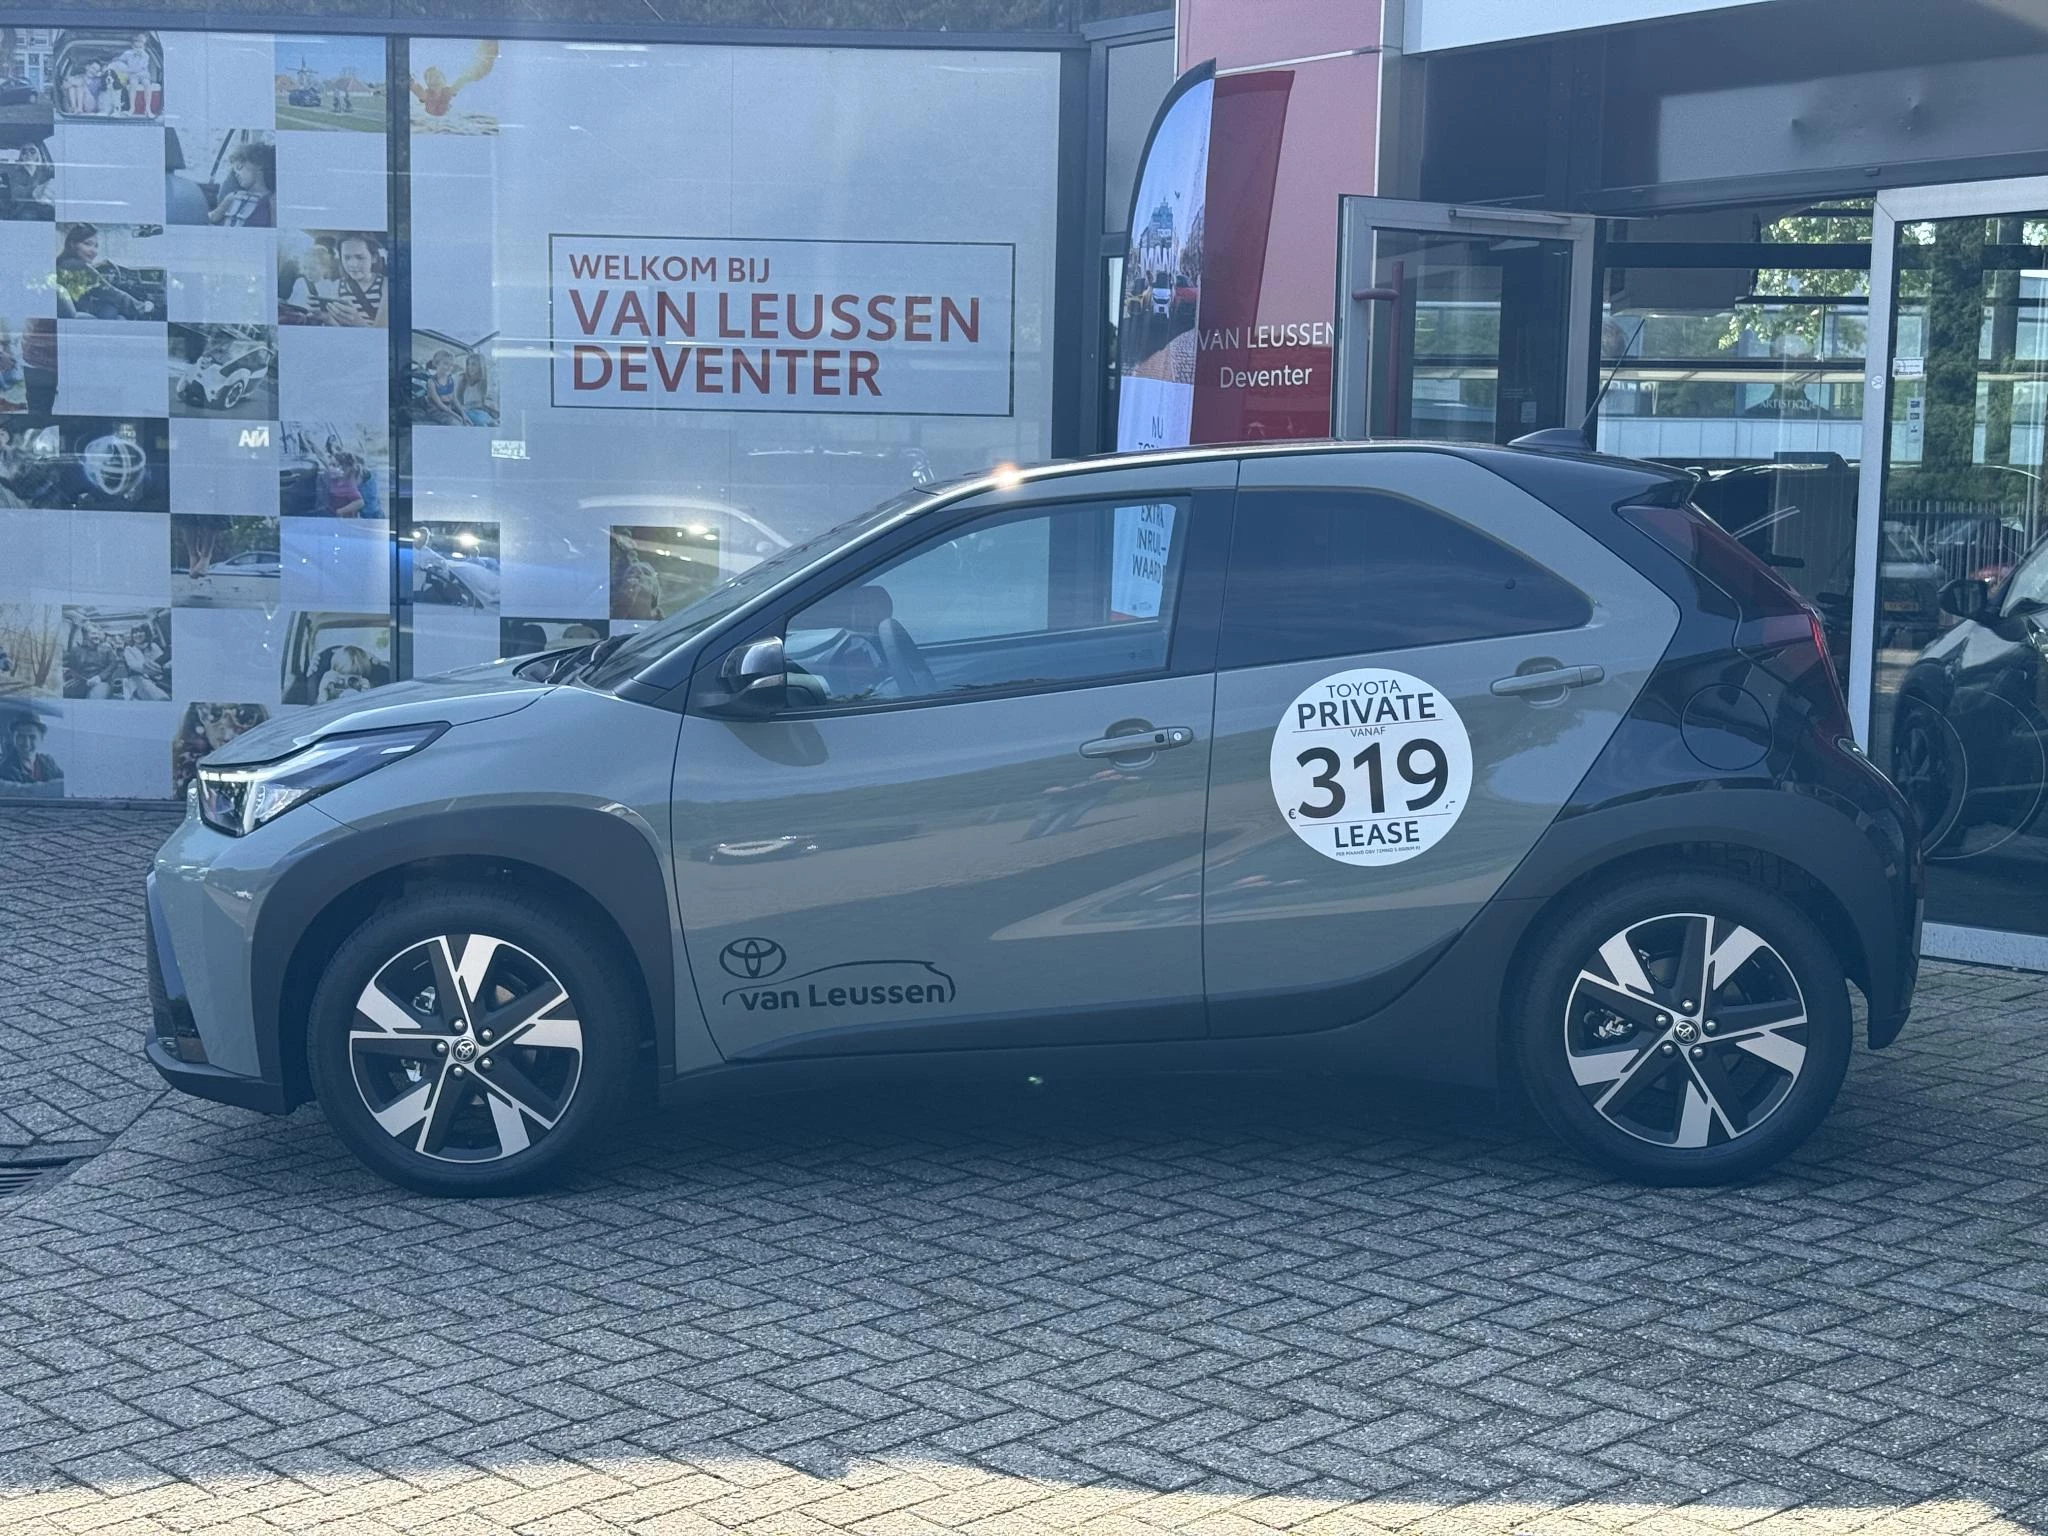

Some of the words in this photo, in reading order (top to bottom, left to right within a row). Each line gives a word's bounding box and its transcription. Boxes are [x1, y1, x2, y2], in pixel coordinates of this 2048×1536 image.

[569, 253, 717, 281] WELKOM
[728, 257, 770, 283] BIJ
[568, 289, 696, 338] VAN
[718, 292, 980, 343] LEUSSEN
[1198, 327, 1240, 351] VAN
[573, 345, 882, 396] DEVENTER
[1219, 365, 1313, 389] Deventer
[1760, 399, 1818, 411] ARTISTIQUE
[1326, 679, 1402, 699] TOYOTA
[1297, 692, 1436, 729] PRIVATE
[1350, 726, 1386, 738] VANAF
[1334, 820, 1420, 848] LEASE
[740, 990, 800, 1011] van
[808, 983, 945, 1007] Leussen
